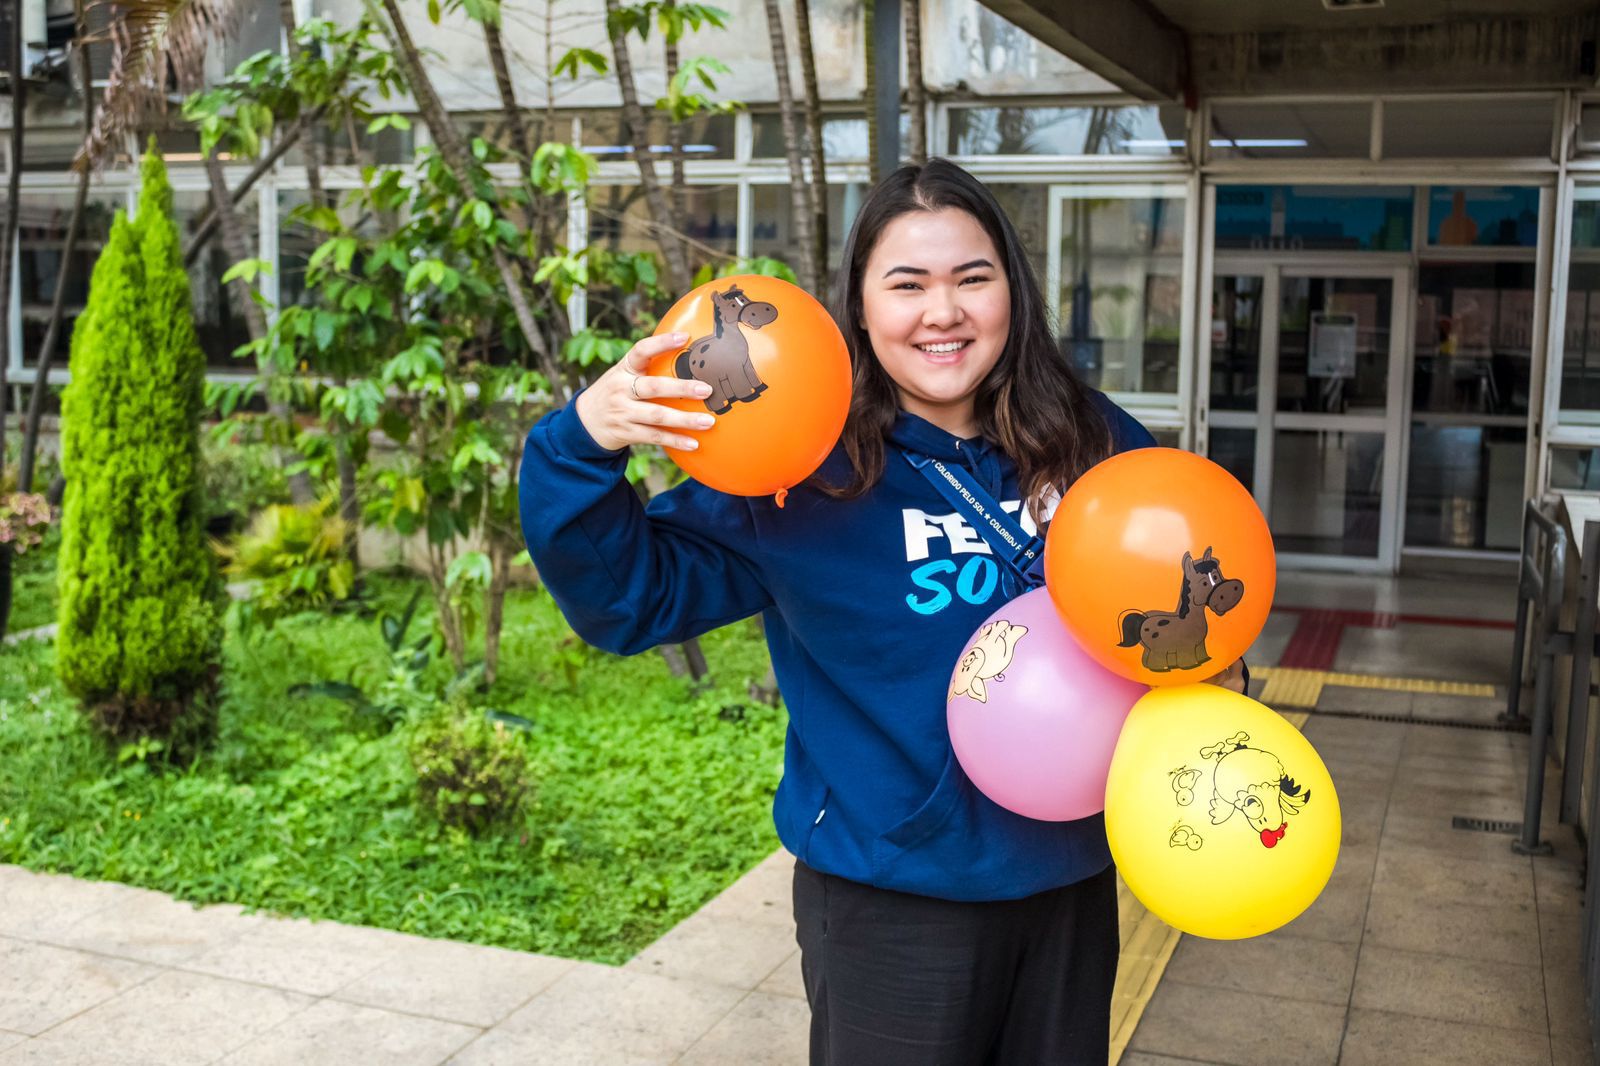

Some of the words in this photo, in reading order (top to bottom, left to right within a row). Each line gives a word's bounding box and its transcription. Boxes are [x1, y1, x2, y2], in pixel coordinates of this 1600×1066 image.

[934, 462, 962, 491] COLORIDO
[959, 486, 975, 505] PELO
[972, 502, 985, 516] SOL
[905, 555, 998, 615] SO
